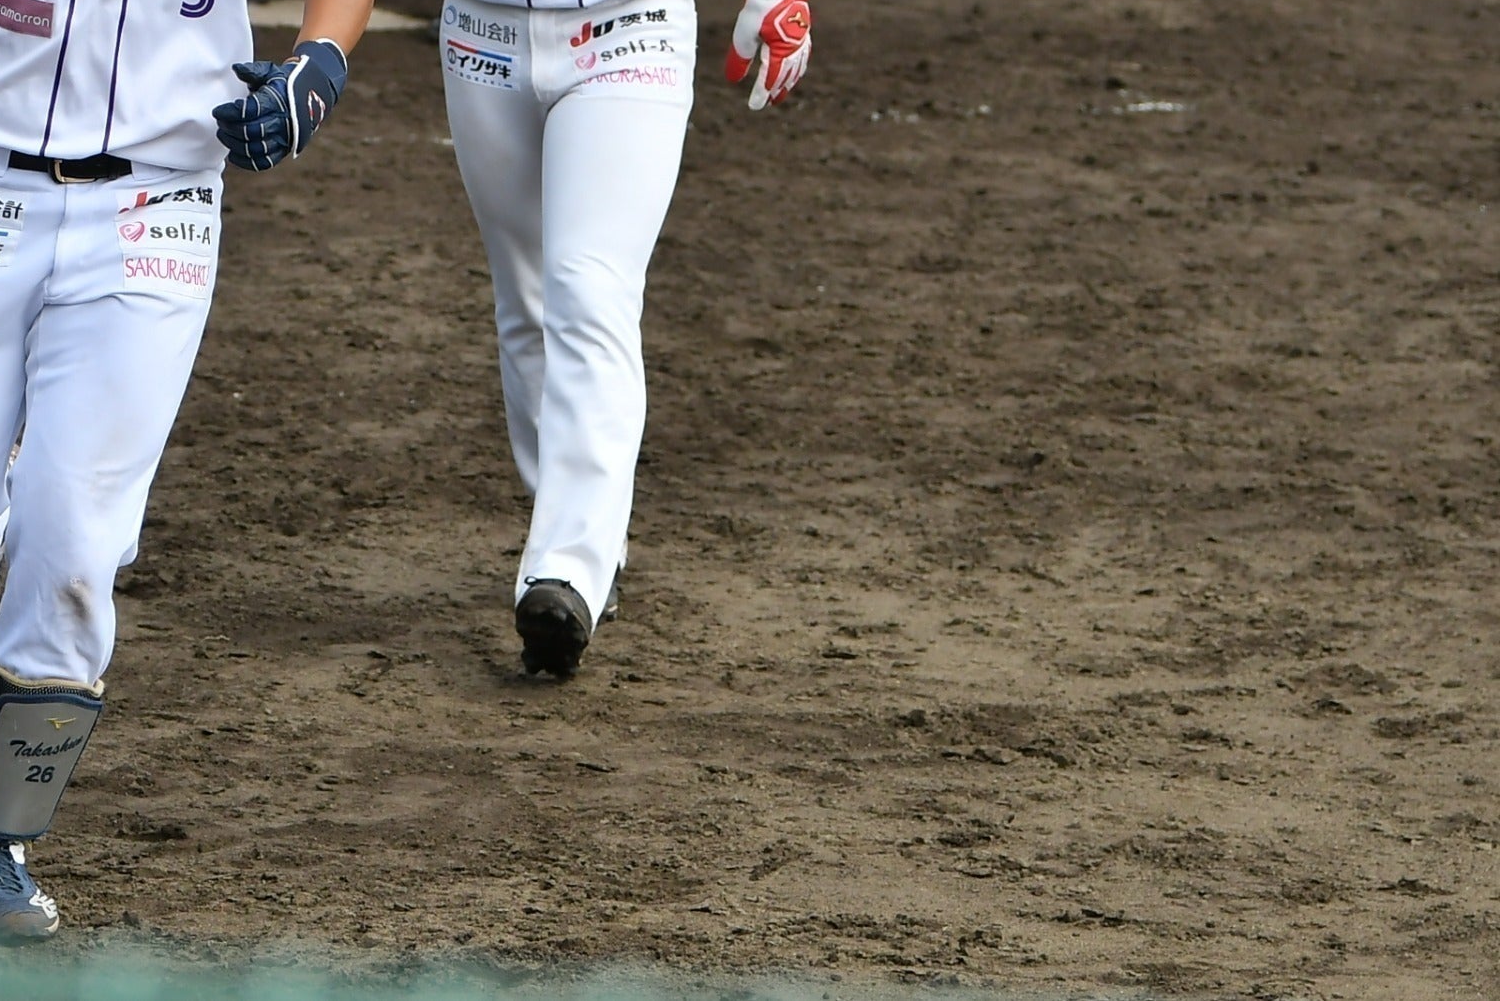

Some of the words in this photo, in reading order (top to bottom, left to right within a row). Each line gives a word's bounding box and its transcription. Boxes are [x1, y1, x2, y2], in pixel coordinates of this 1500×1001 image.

[458, 11, 518, 46] 増山会計
[457, 54, 512, 80] イソザキ
[149, 222, 211, 246] self-A
[24, 764, 56, 784] 26
